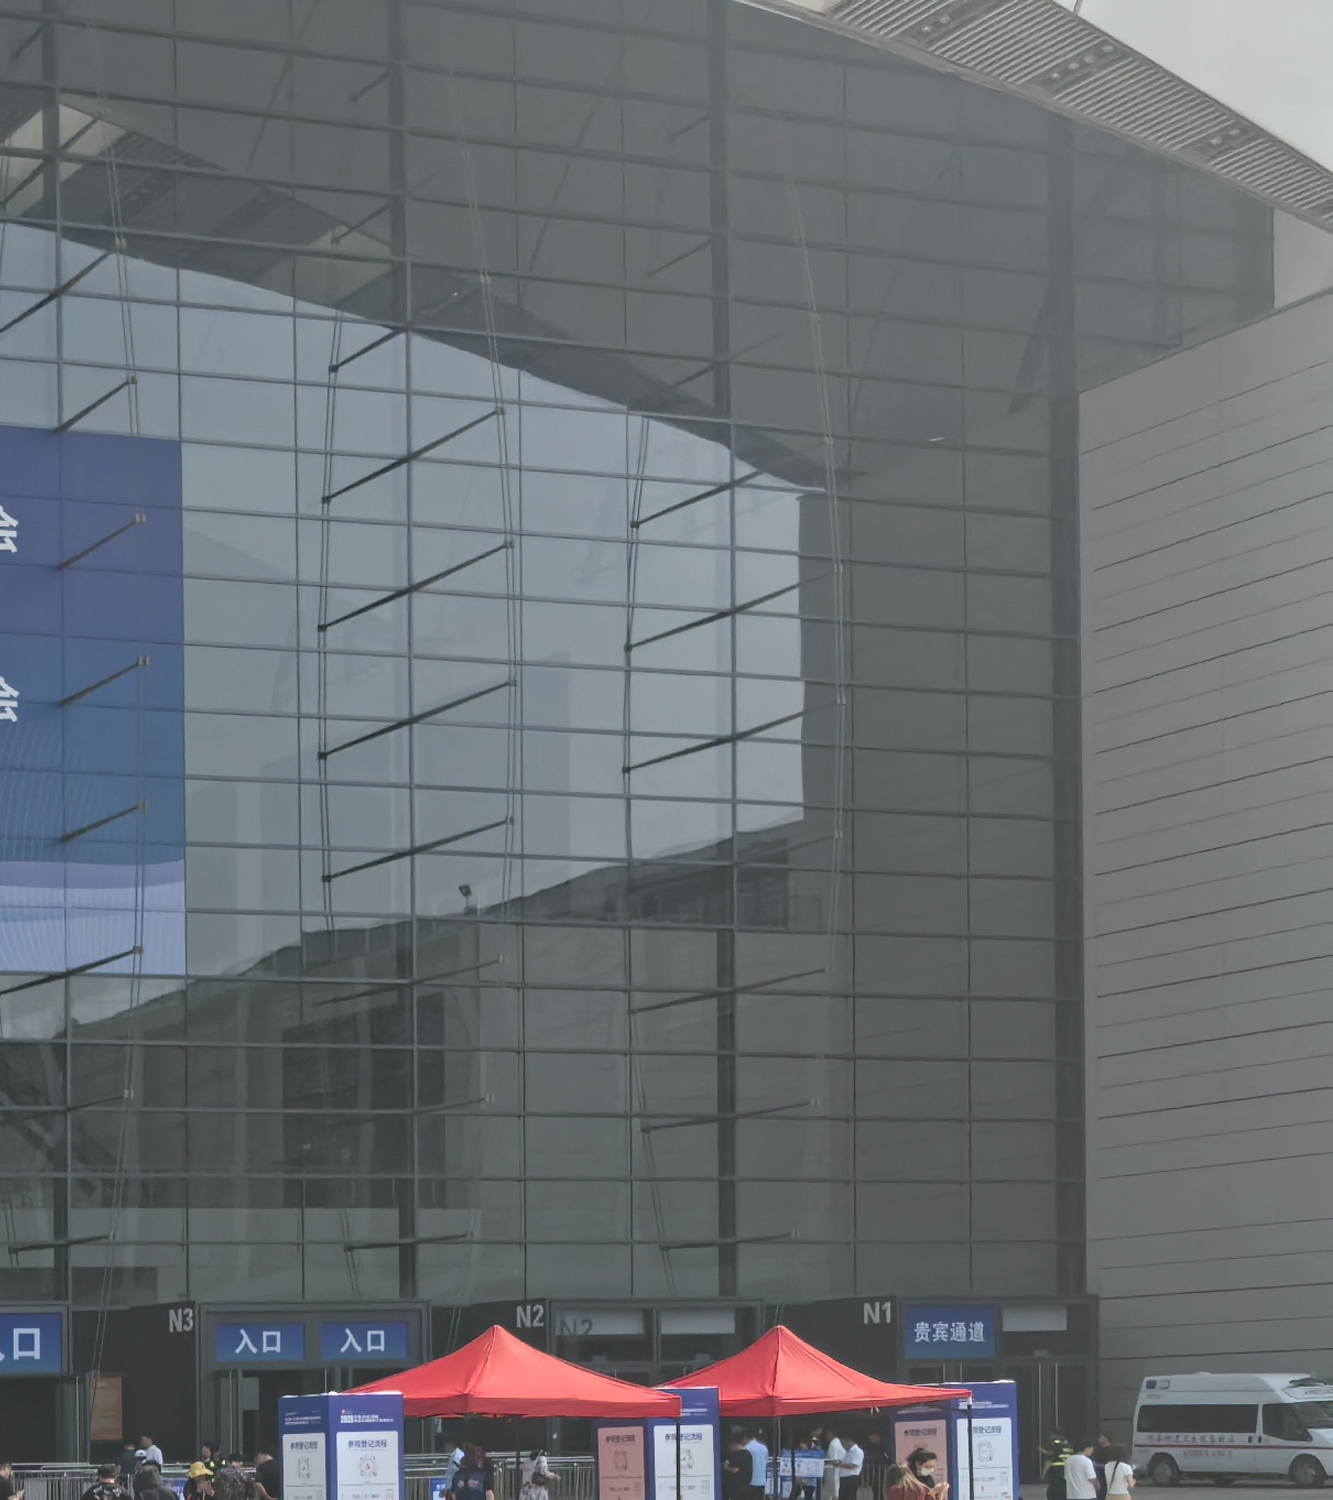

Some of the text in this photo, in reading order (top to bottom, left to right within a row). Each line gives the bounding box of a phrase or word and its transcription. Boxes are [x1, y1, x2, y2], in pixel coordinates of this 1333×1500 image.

[168, 1308, 194, 1332] N3
[516, 1304, 544, 1329] N2
[863, 1301, 892, 1325] N1
[235, 1328, 282, 1354] 入口
[340, 1327, 386, 1353] 入口
[913, 1320, 985, 1344] 贵宾通道
